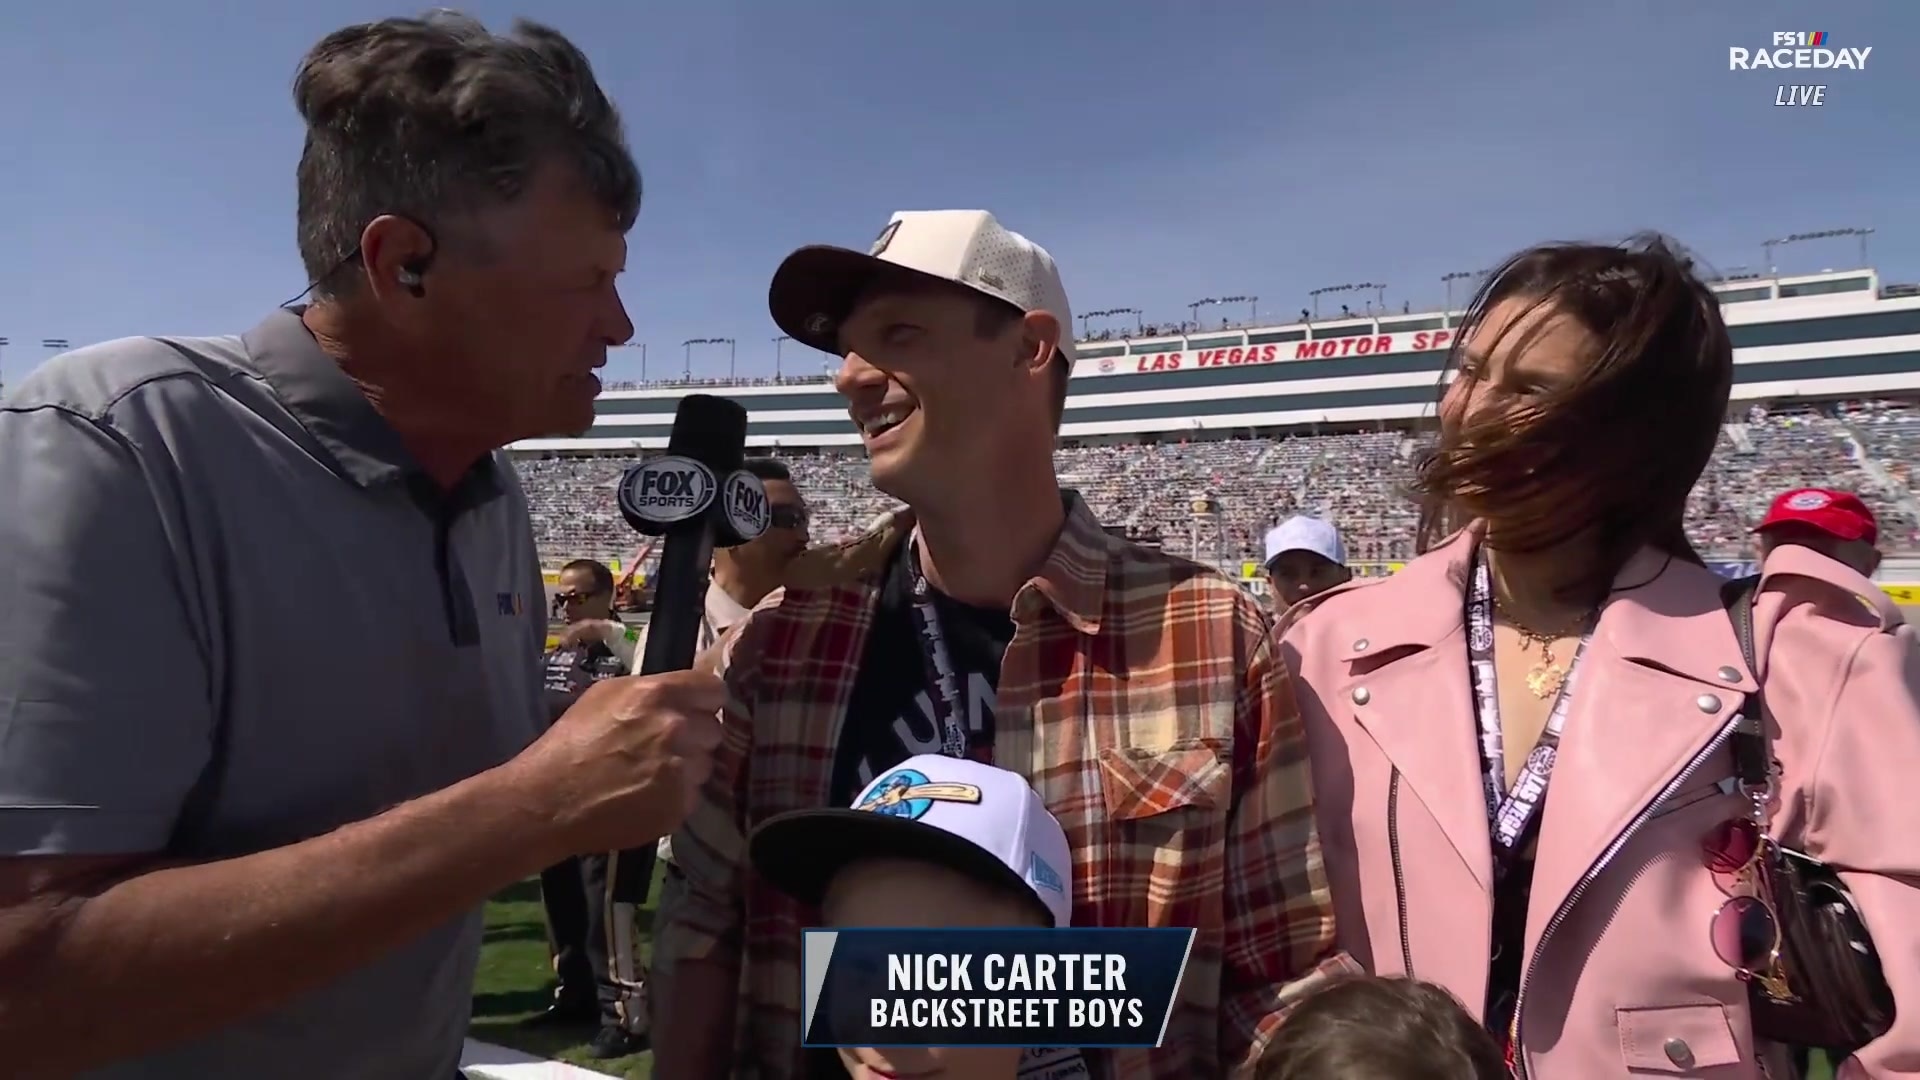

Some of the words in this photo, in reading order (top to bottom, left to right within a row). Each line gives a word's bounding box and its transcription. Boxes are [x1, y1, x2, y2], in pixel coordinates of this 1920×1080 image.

[1137, 353, 1182, 372] LAS
[1197, 345, 1277, 368] VEGAS
[1295, 334, 1393, 359] MOTOR
[1412, 330, 1450, 350] SP
[641, 471, 696, 496] FOX
[735, 480, 764, 519] FOX
[639, 496, 695, 507] SPORTS
[733, 506, 762, 529] SPORTS
[1518, 772, 1547, 805] LAS
[1496, 801, 1532, 848] VEGAS
